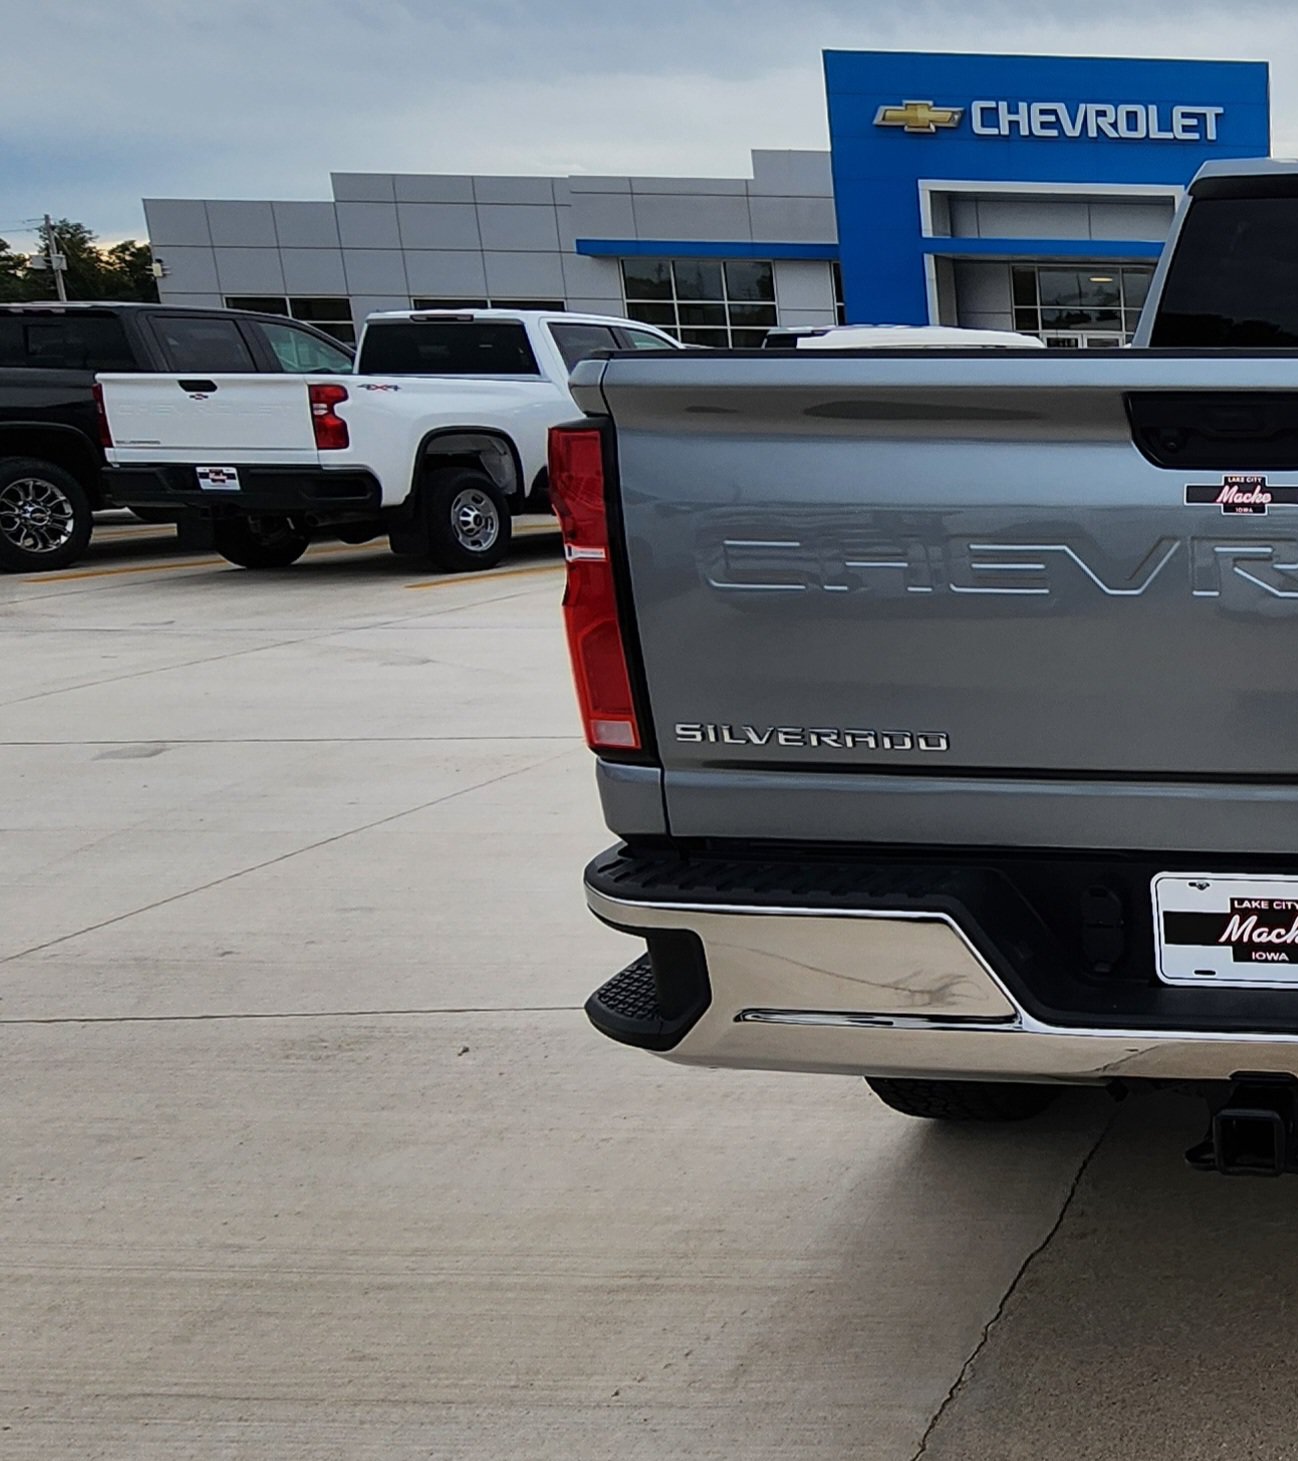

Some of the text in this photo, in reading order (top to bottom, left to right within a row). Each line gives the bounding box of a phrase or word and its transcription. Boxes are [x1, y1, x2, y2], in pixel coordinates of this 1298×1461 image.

[971, 100, 1225, 140] CHEVROLET
[1215, 485, 1272, 503] Macke
[674, 723, 949, 751] SILVERADO
[1234, 900, 1269, 909] LAKE
[1252, 951, 1289, 961] IOWA
